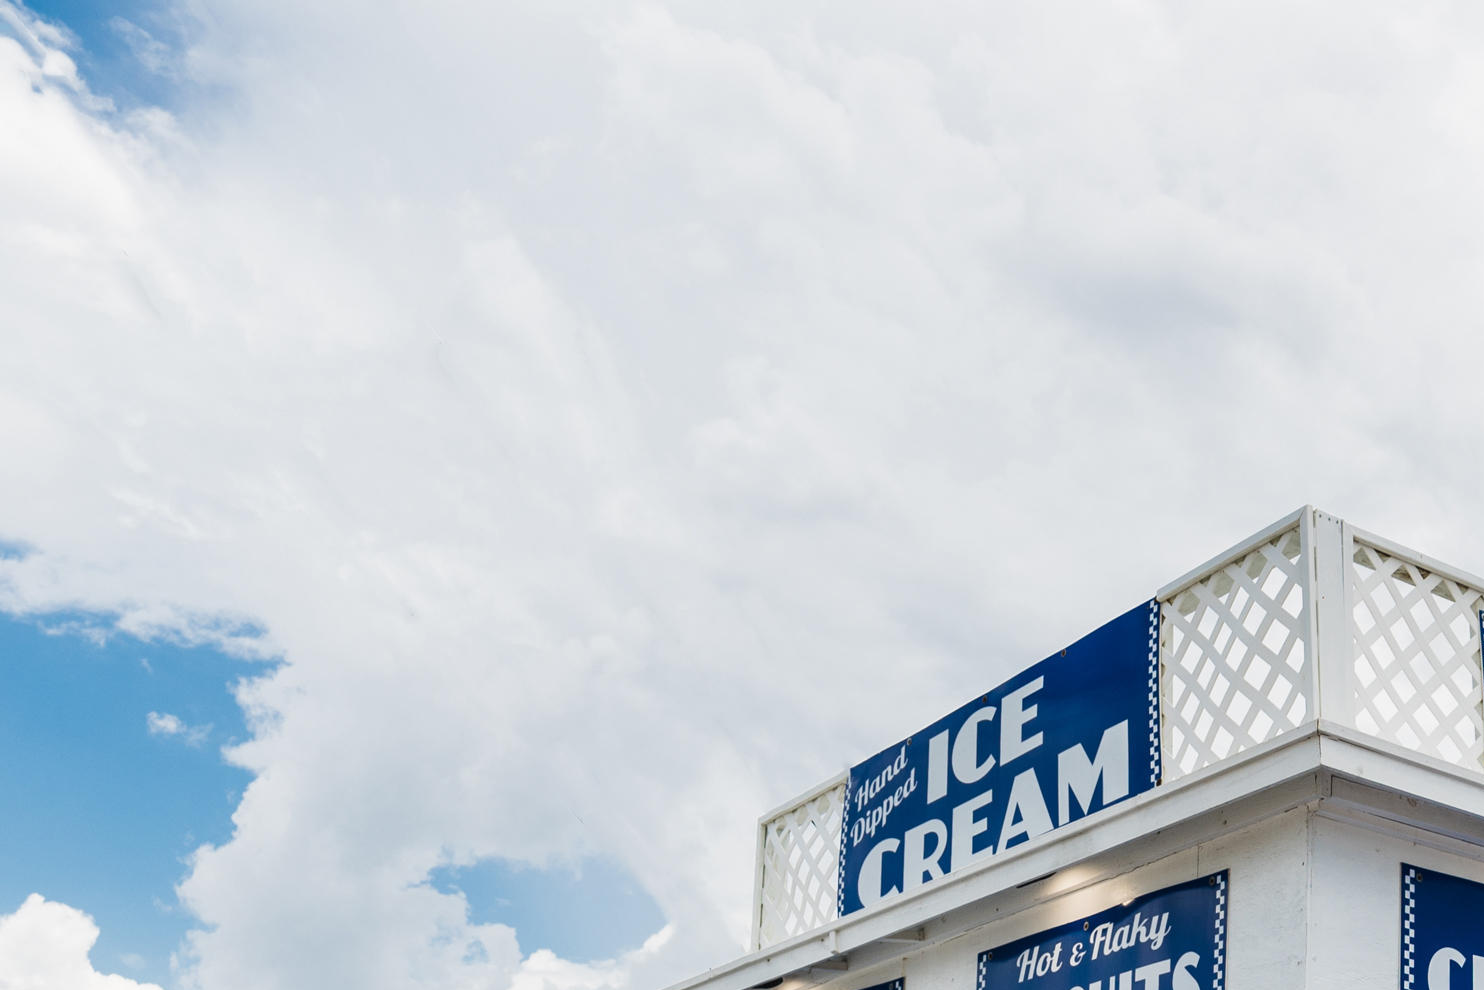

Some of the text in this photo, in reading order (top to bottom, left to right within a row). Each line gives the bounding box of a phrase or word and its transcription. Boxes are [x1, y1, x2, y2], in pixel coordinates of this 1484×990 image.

[855, 745, 908, 812] Hand
[927, 675, 1044, 804] ICE
[850, 767, 918, 847] Dipped
[857, 719, 1129, 908] CREAM
[1016, 912, 1172, 983] Hot & Flaky
